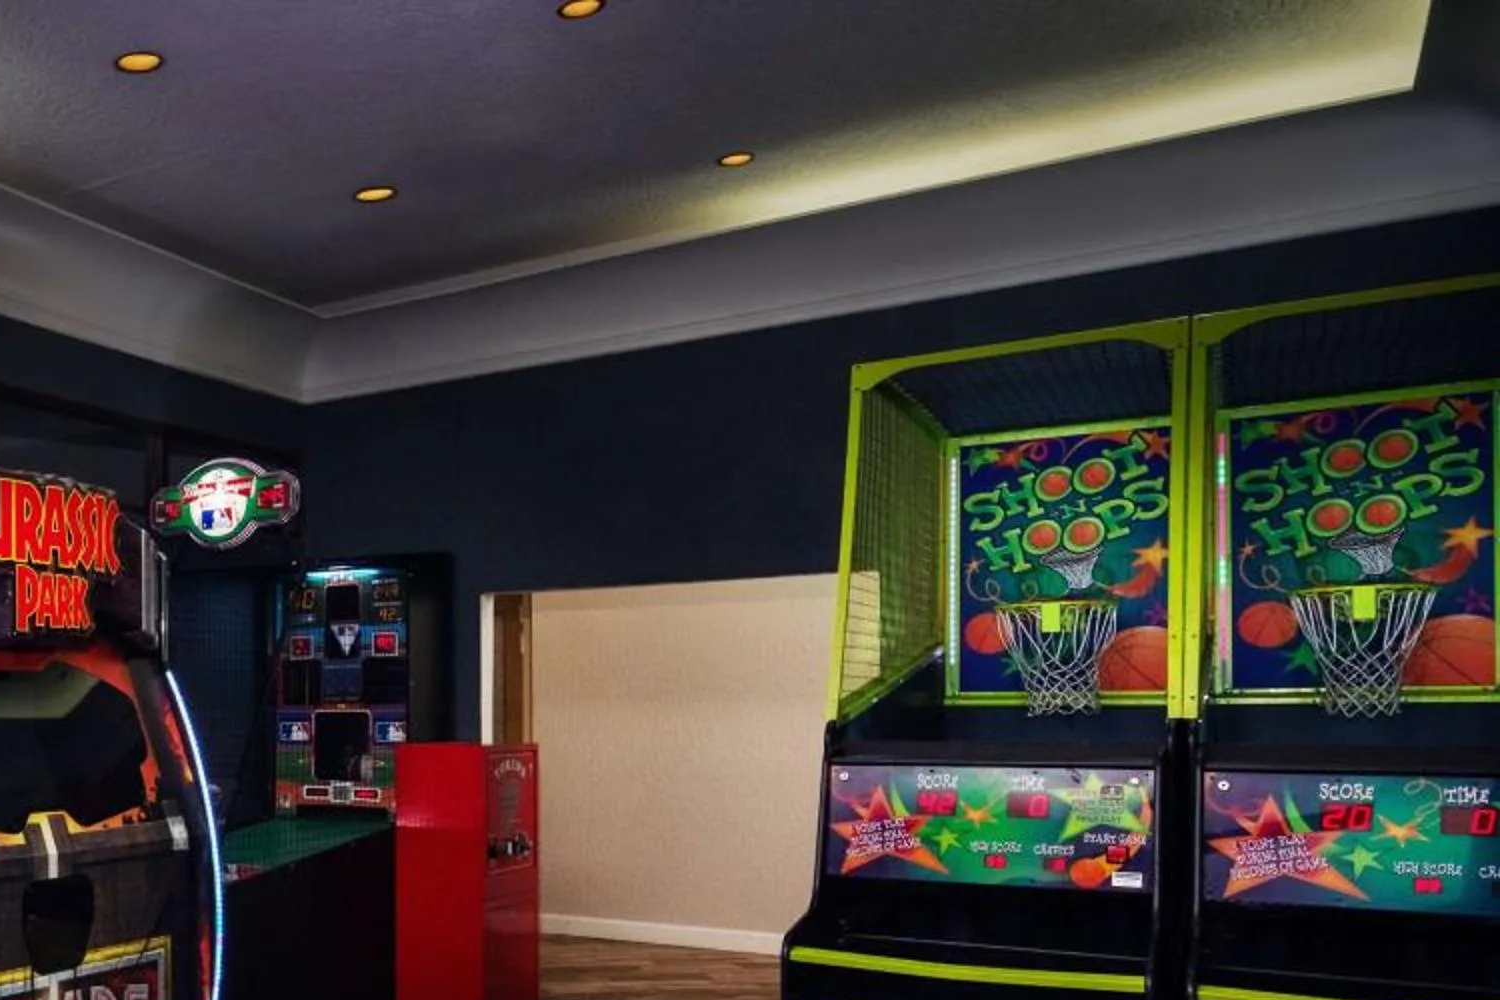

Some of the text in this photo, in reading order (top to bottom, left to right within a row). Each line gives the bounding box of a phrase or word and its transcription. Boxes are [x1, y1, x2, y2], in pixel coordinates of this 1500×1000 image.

[1235, 401, 1460, 512] SHOOT
[964, 434, 1148, 531] SHOOT
[1251, 448, 1484, 558] HOOPS
[976, 477, 1168, 573] HOOPS
[15, 563, 94, 636] PARK
[1318, 782, 1375, 801] SCORE
[1443, 785, 1491, 805] TIME
[1321, 803, 1373, 832] 20
[1468, 807, 1498, 835] 0
[1422, 862, 1463, 877] SCORE
